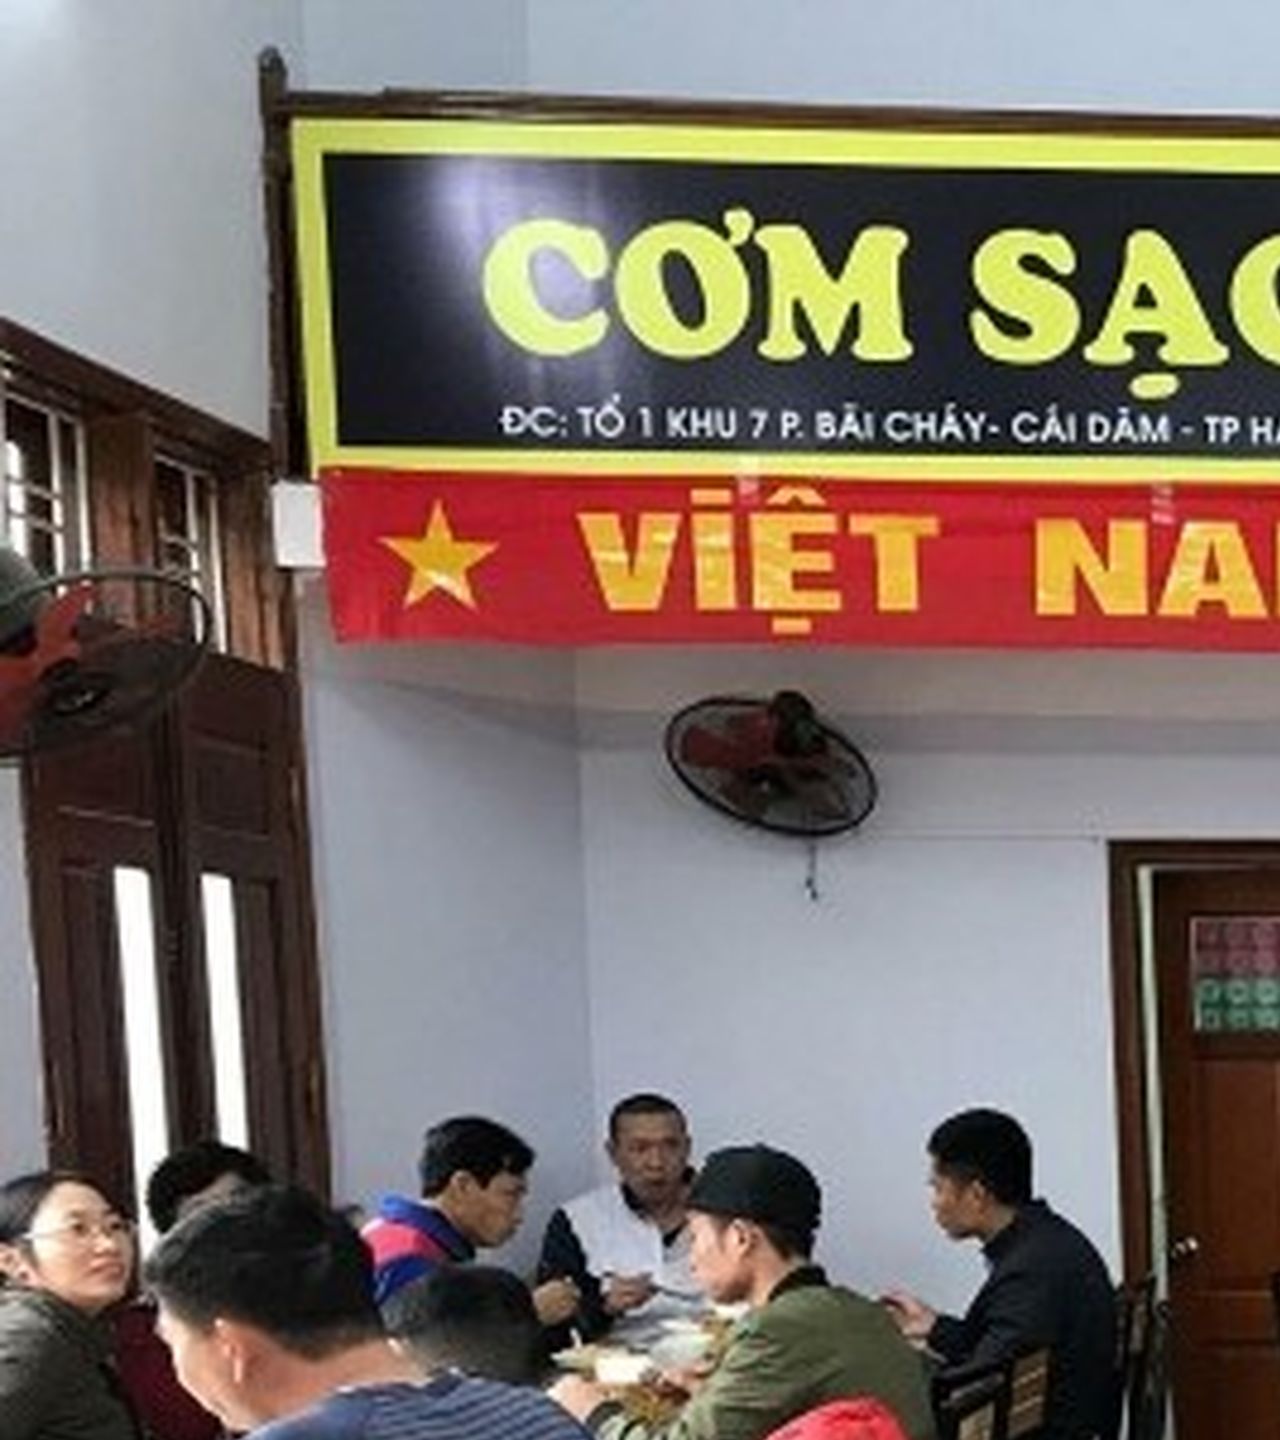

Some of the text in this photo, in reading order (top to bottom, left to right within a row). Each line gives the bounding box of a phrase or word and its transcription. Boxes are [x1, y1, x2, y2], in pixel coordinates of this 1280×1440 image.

[482, 207, 915, 363] CƠM
[499, 406, 567, 437] ĐC:
[667, 408, 737, 439] KHU
[750, 409, 769, 439] 7
[780, 410, 804, 439] P.
[815, 403, 874, 440] BÃI
[1011, 404, 1076, 443] CÁI
[1204, 415, 1240, 443] TP
